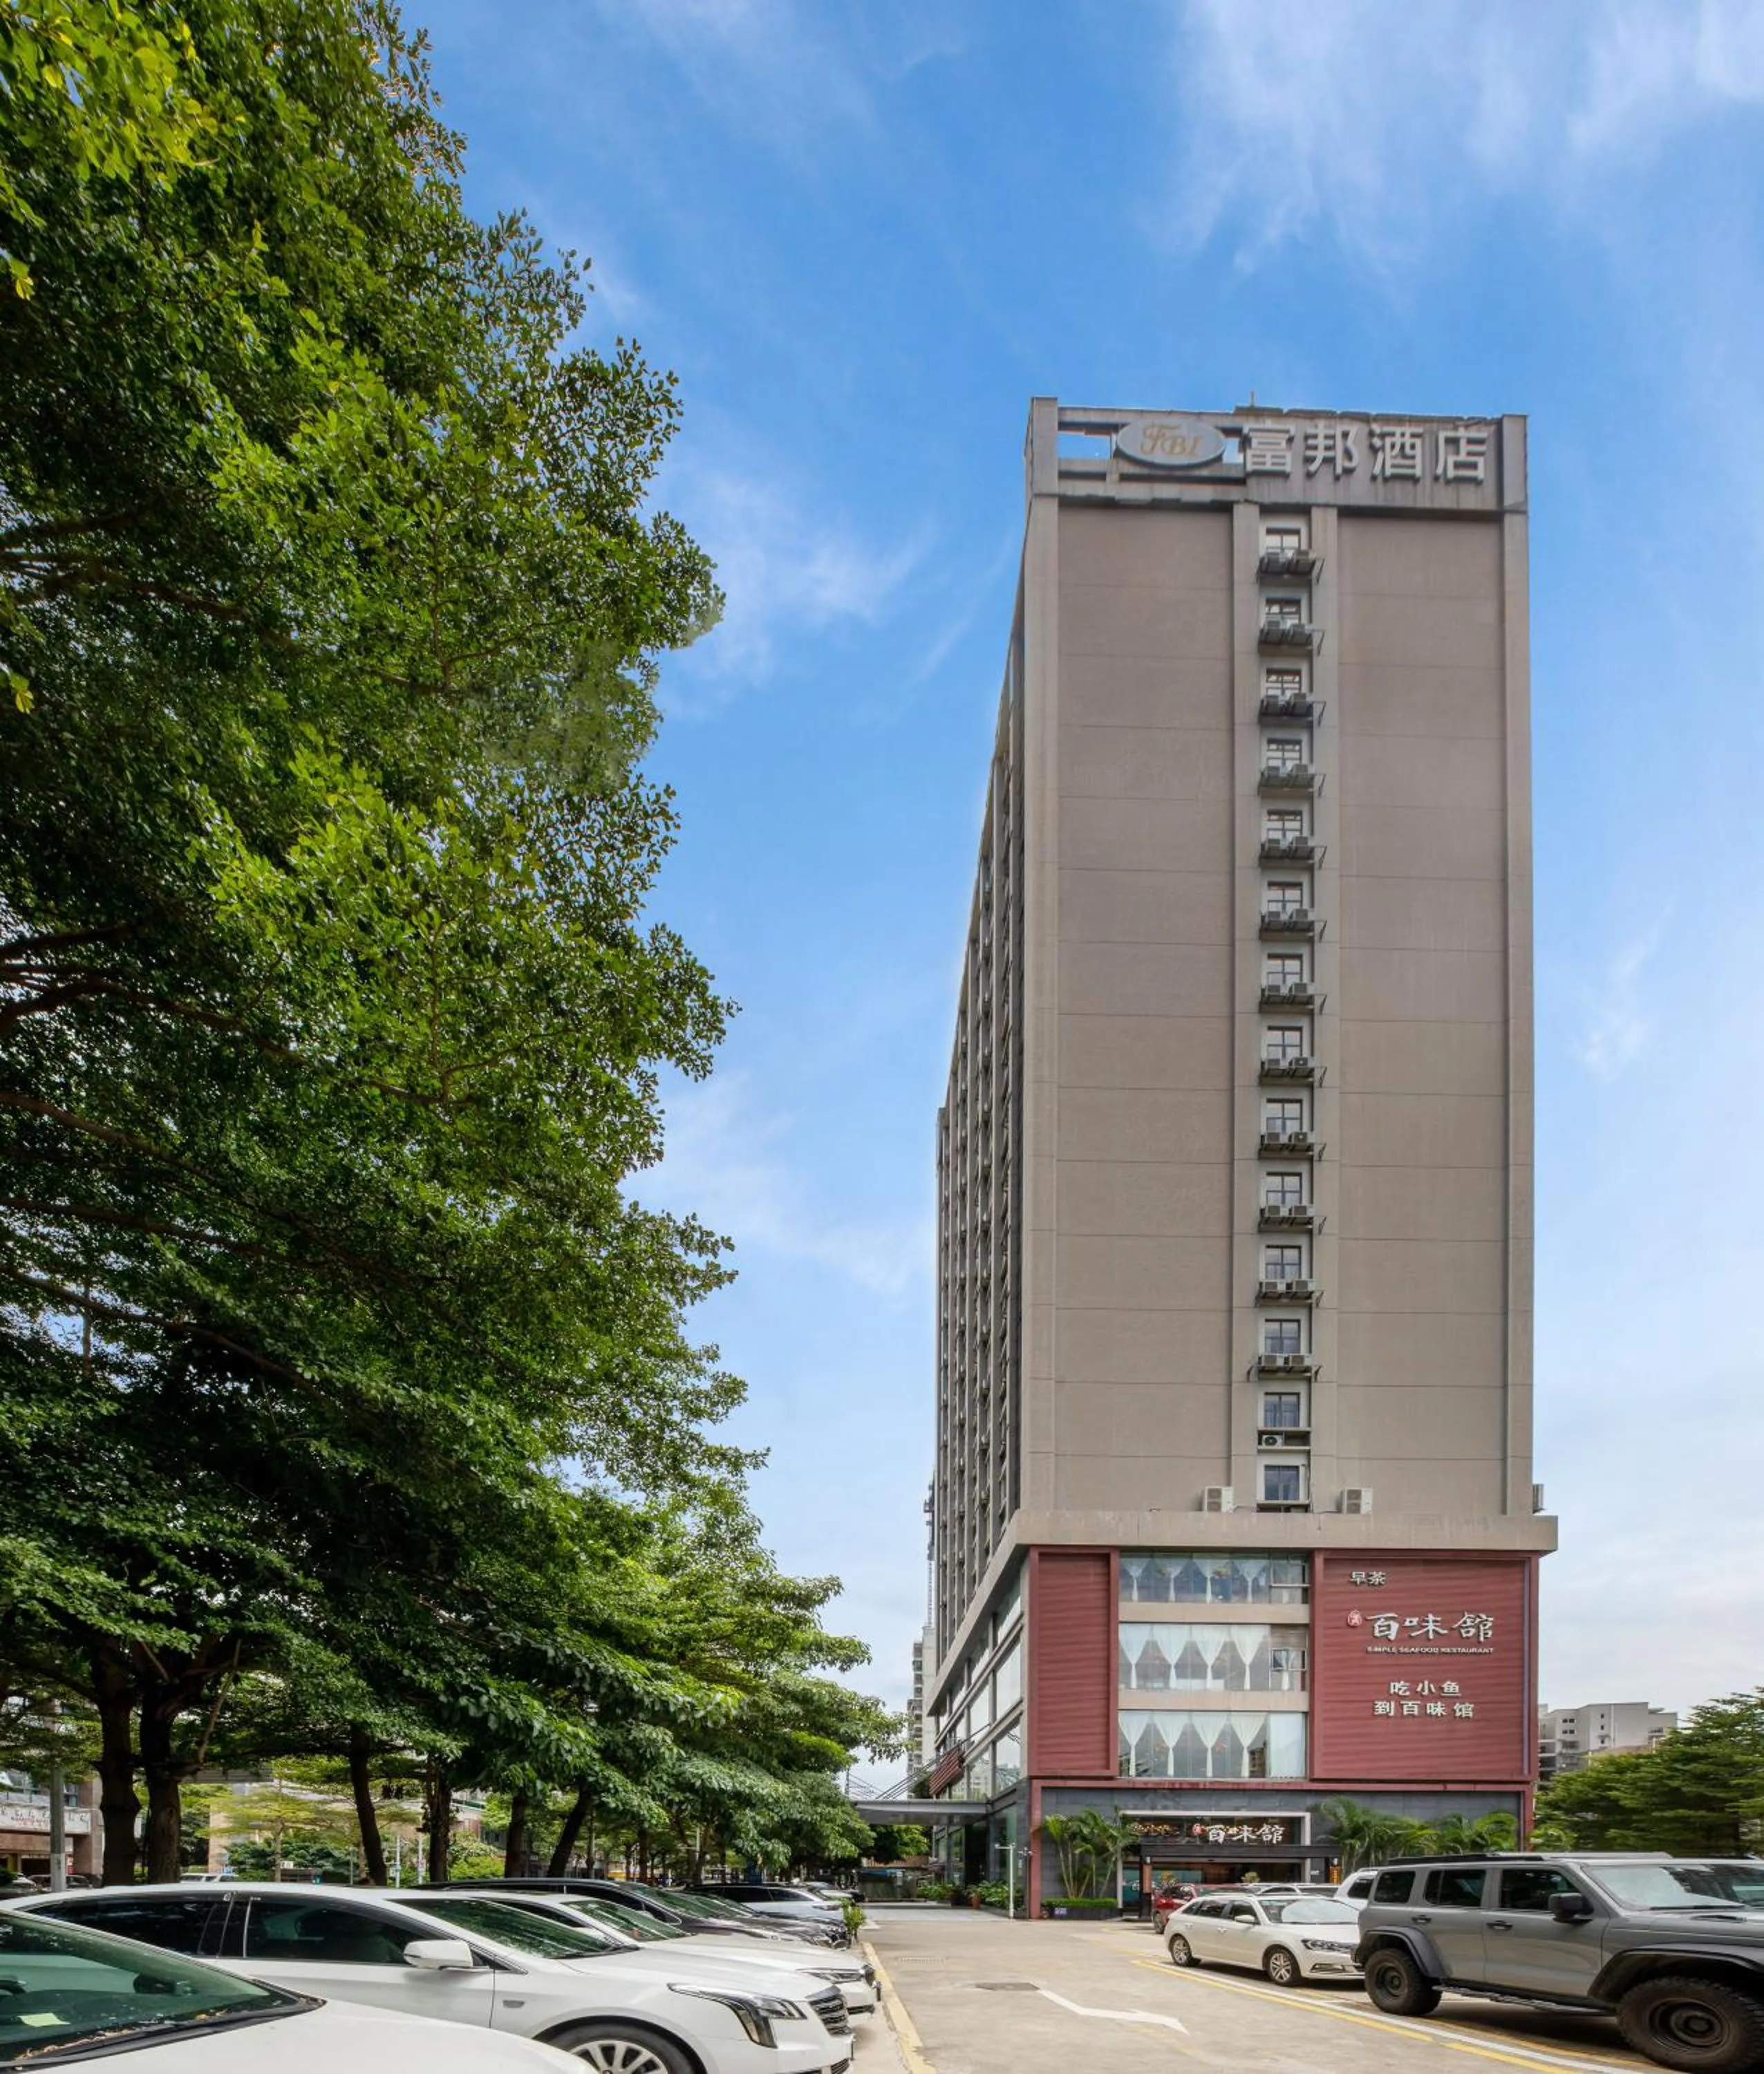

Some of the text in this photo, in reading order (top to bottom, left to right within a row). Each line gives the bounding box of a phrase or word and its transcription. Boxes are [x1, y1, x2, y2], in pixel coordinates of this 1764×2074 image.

[1246, 420, 1488, 483] 富邦酒店
[1350, 1571, 1385, 1585] 早茶
[1390, 1681, 1461, 1696] 吃小鱼
[1374, 1701, 1474, 1717] 到百味馆
